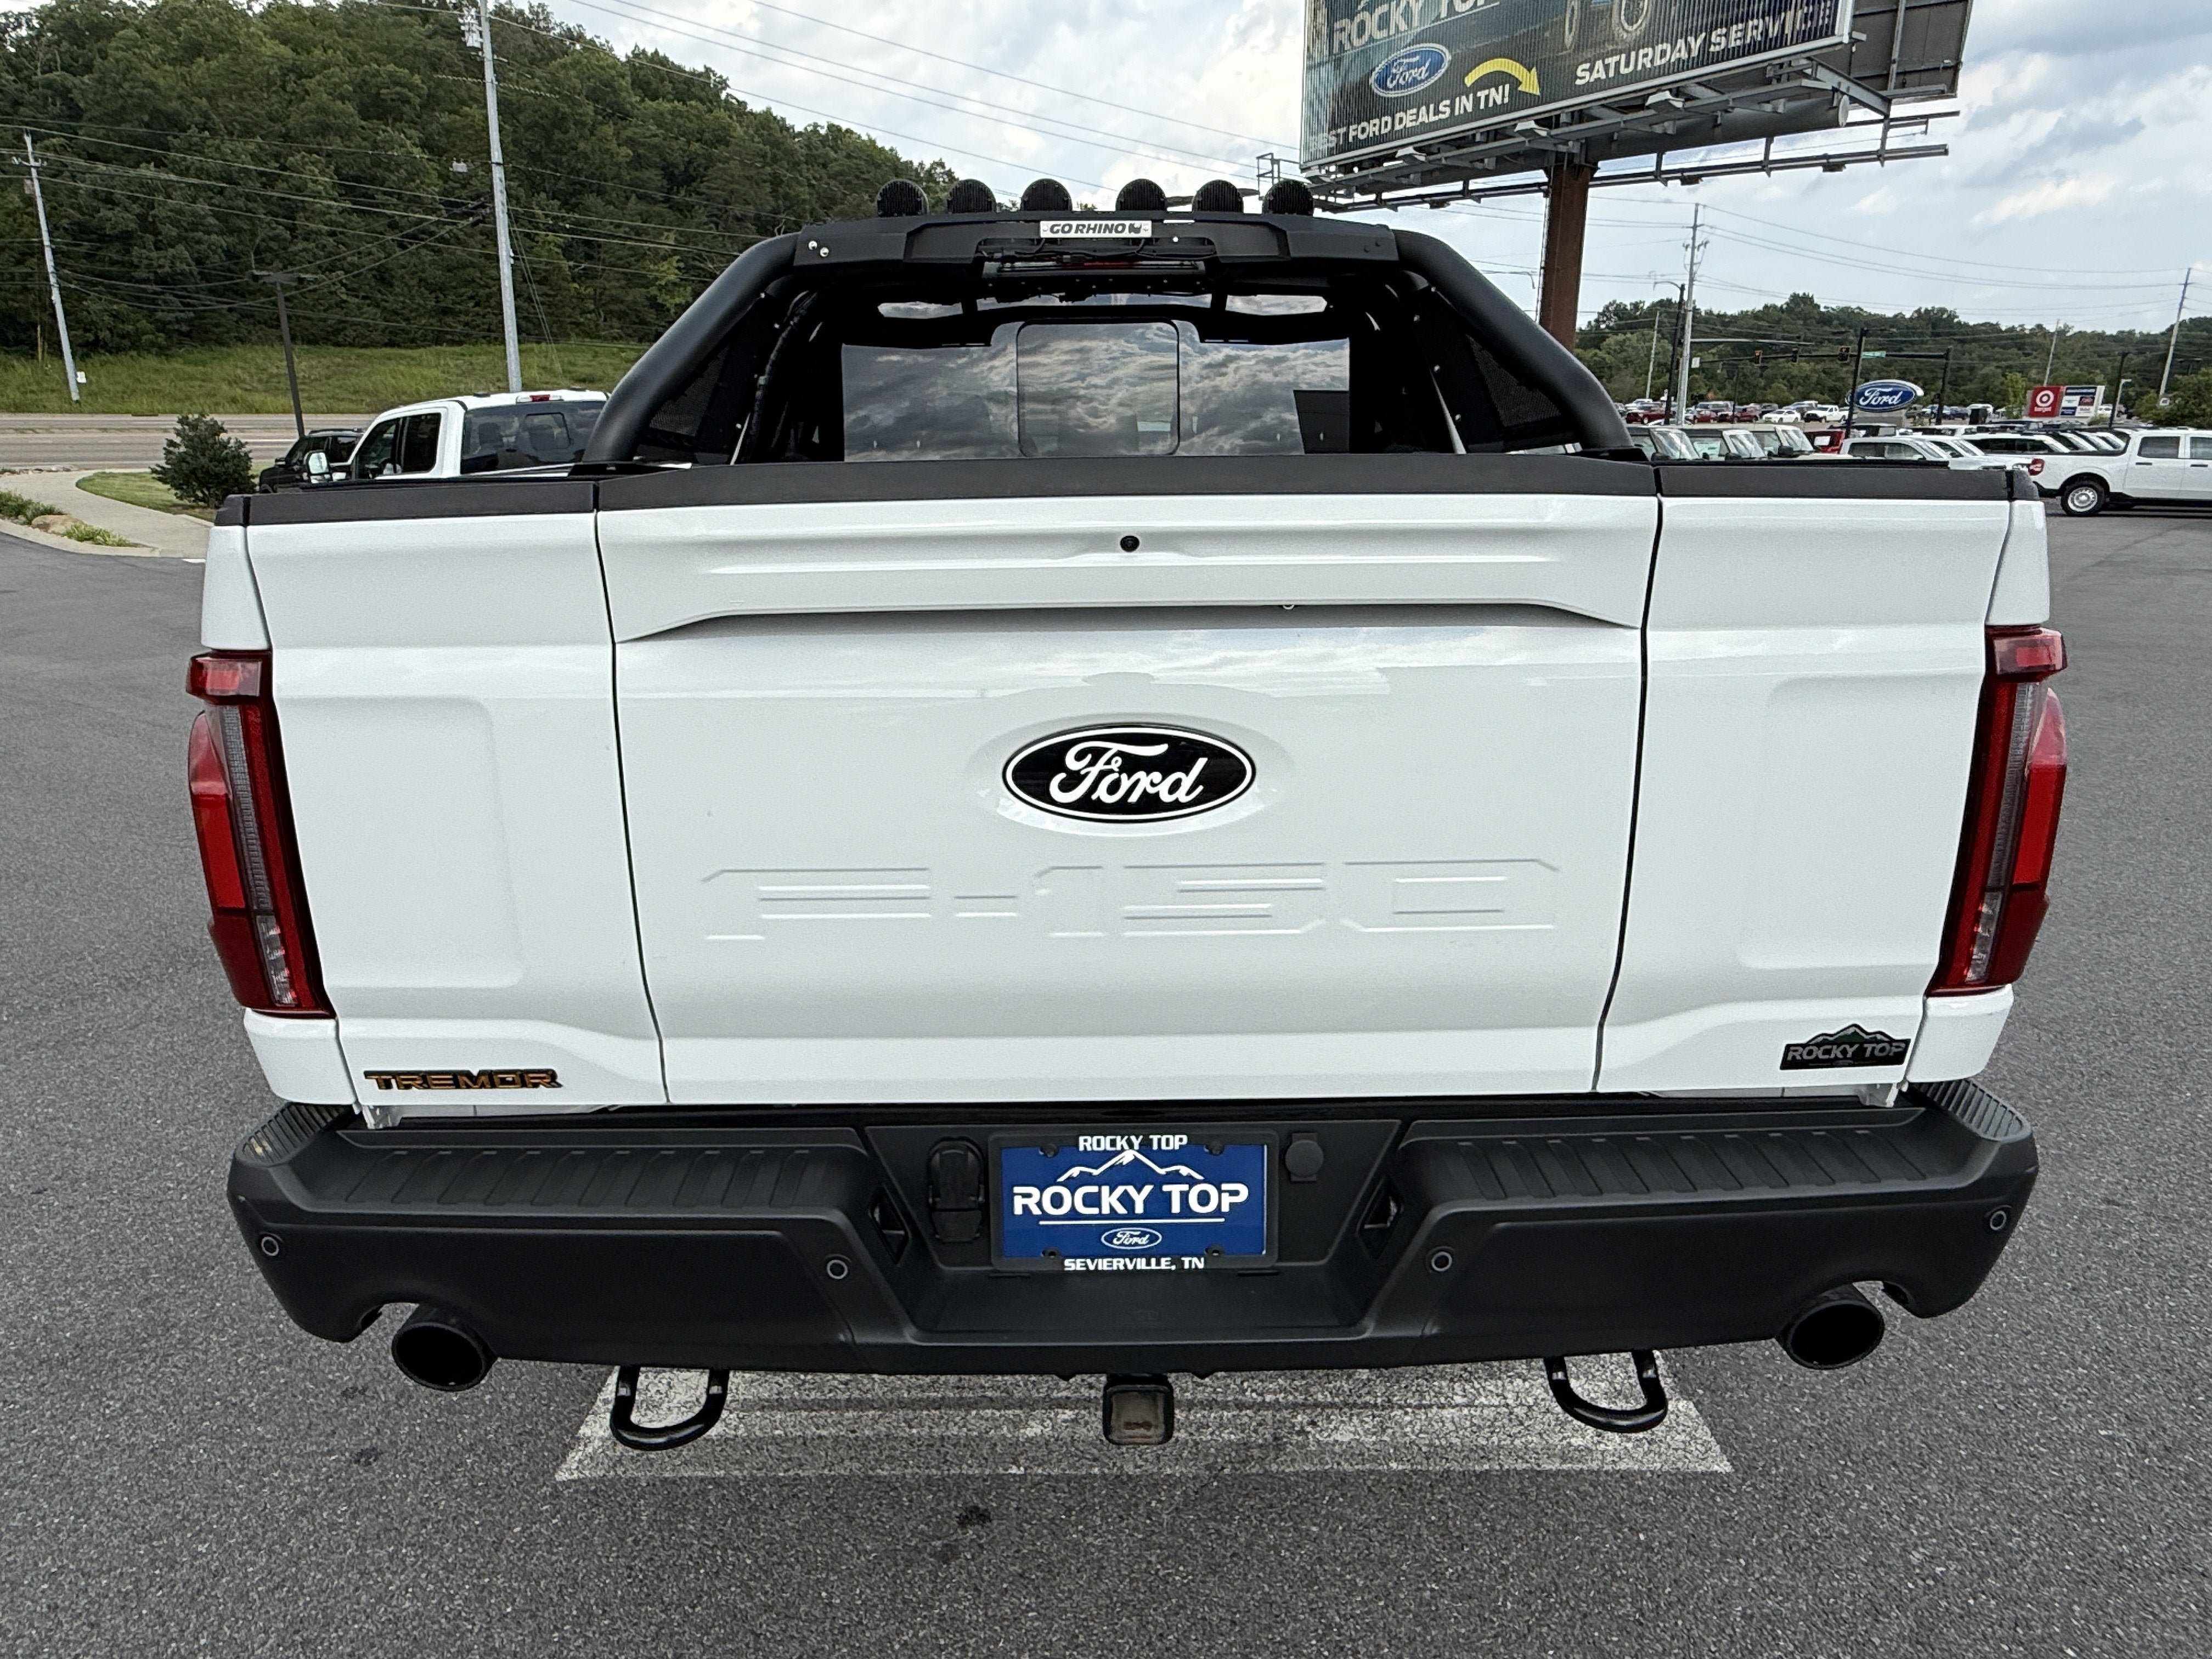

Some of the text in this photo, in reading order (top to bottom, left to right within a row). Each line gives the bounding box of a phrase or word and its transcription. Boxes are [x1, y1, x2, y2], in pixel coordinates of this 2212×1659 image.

[1333, 0, 1425, 54] ROCKY
[1575, 32, 1706, 86] SATURDAY
[1387, 55, 1431, 88] Ford
[1348, 115, 1392, 142] FORD
[1394, 100, 1451, 131] DEALS
[1455, 93, 1474, 116] IN
[1476, 83, 1510, 110] TN!
[1049, 223, 1126, 234] GO RHINO
[1859, 388, 1903, 406] Ford
[1049, 741, 1208, 804] Ford
[1787, 1042, 1906, 1061] ROCKY TOP
[364, 1069, 563, 1091] TREMOR
[1079, 1135, 1188, 1152] ROCKY TOP
[1013, 1183, 1249, 1216] ROCKY TOP
[1112, 1231, 1150, 1246] Ford
[1064, 1257, 1205, 1271] SEVIERVILLE, TN
